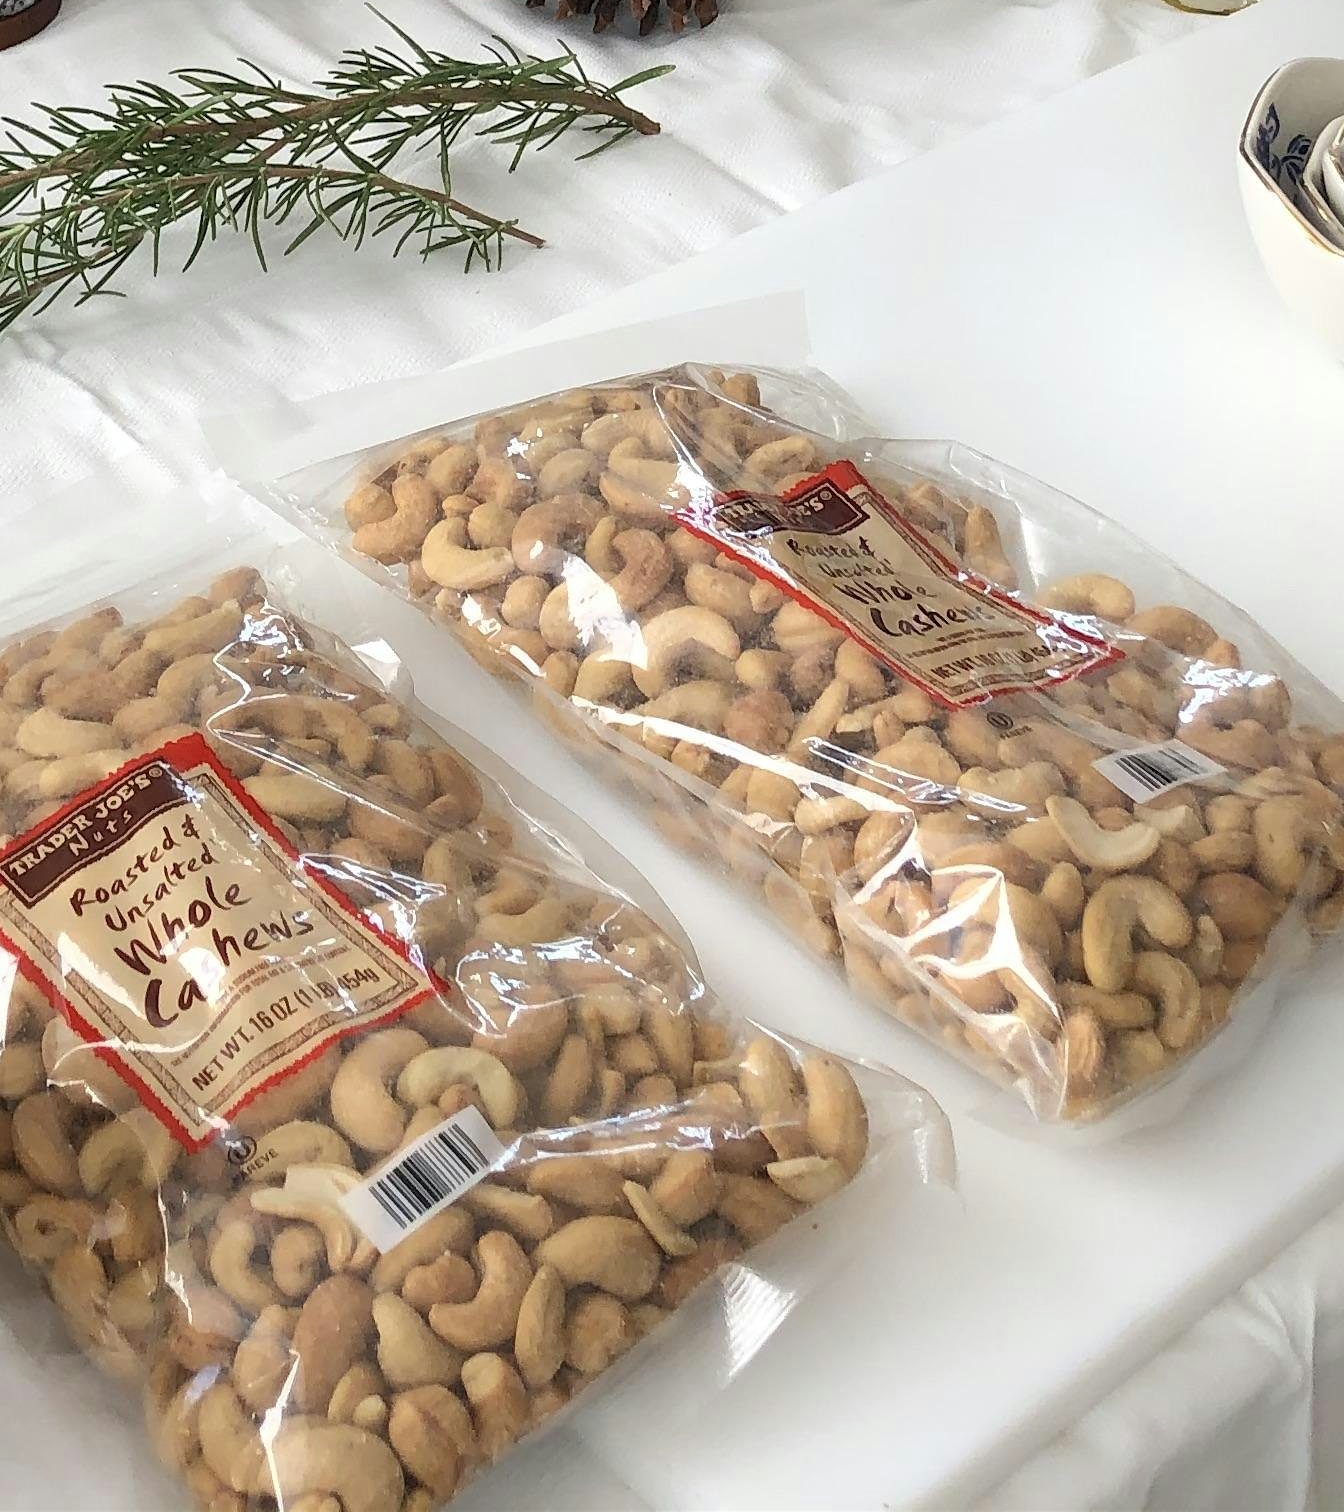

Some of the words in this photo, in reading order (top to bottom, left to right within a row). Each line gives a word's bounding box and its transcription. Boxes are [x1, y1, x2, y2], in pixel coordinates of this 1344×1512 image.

[833, 578, 937, 605] Whole
[9, 814, 93, 876] TRADER
[69, 810, 132, 857] Nuts
[69, 825, 182, 917] Roasted
[181, 813, 200, 840] &
[105, 842, 221, 932] Unsalted
[113, 875, 253, 976] Whole
[144, 910, 315, 1029] Cahews
[192, 1055, 225, 1092] NET
[220, 1025, 255, 1061] WT.
[249, 1010, 275, 1034] 16
[270, 996, 298, 1022] OZ
[293, 987, 312, 1008] (1
